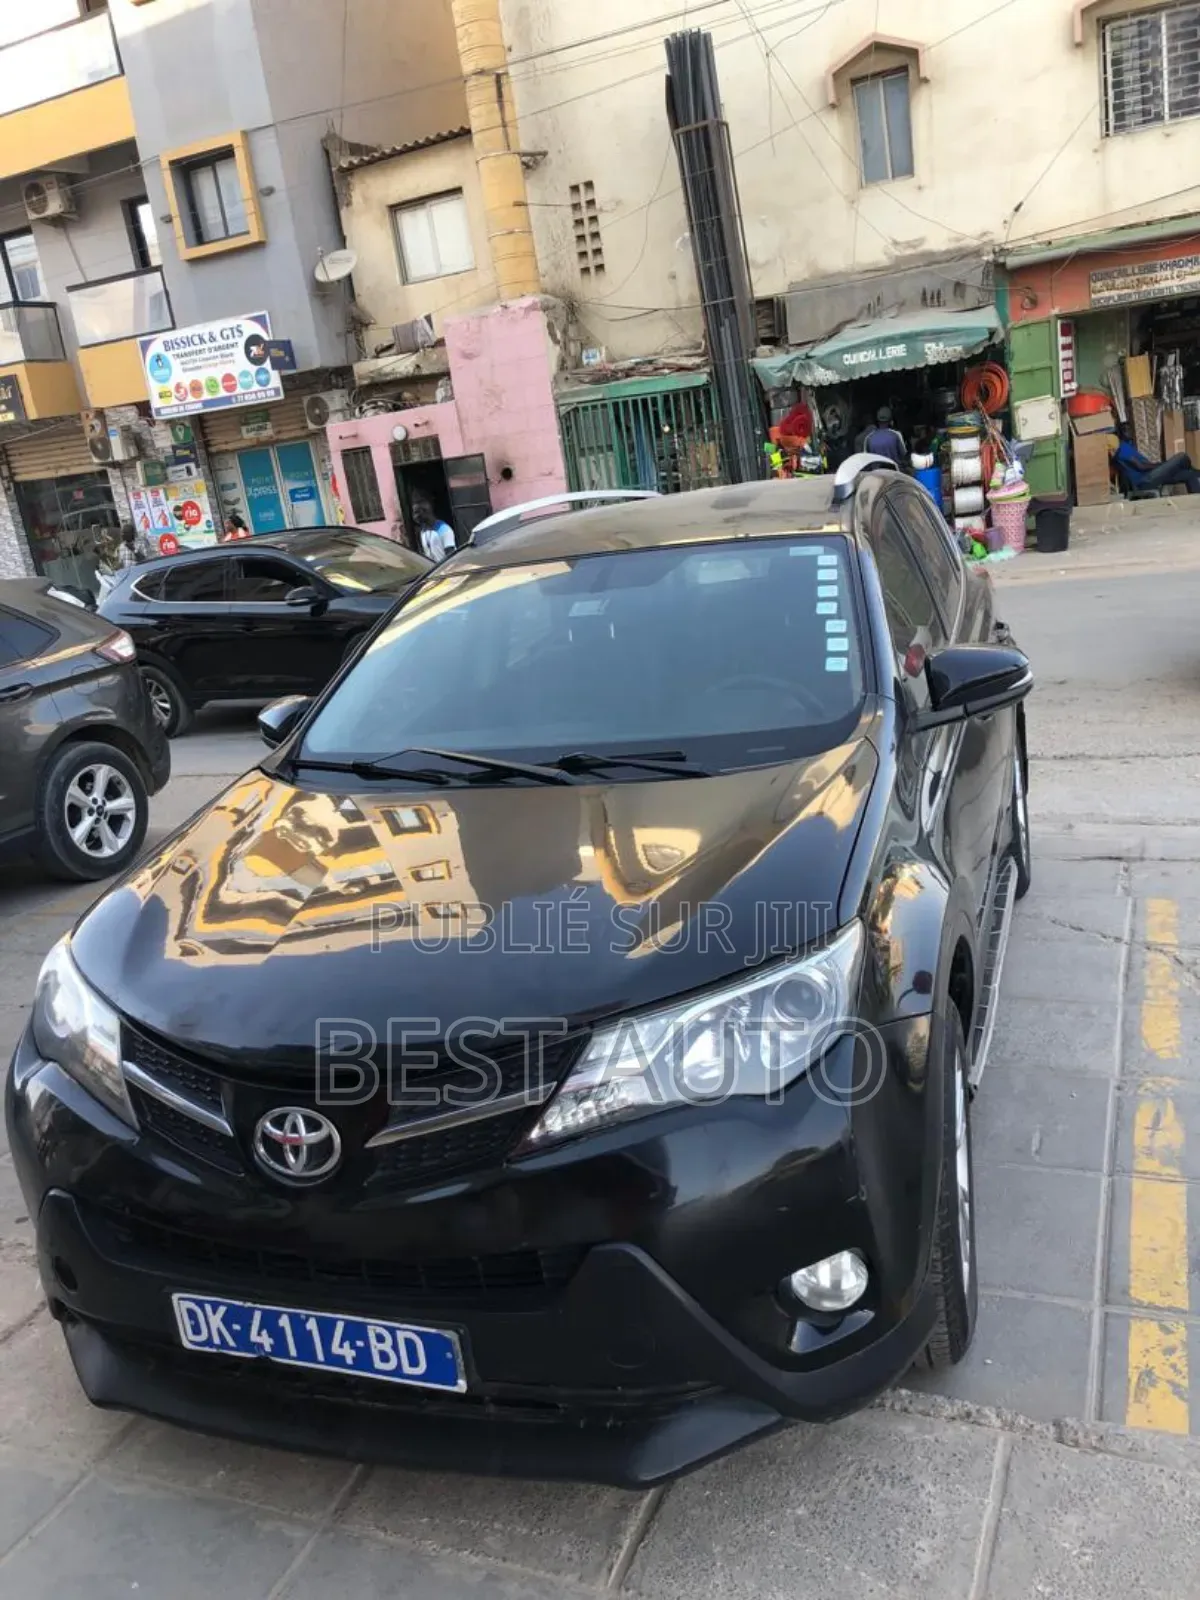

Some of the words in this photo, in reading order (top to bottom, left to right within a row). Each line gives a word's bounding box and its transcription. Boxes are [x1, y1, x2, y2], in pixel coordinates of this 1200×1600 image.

[163, 334, 208, 352] BISSICK
[208, 331, 217, 346] &
[220, 324, 244, 341] GTS
[172, 347, 206, 359] TRANSFERT
[184, 506, 198, 518] ria
[178, 1300, 427, 1375] DK-4114-BD
